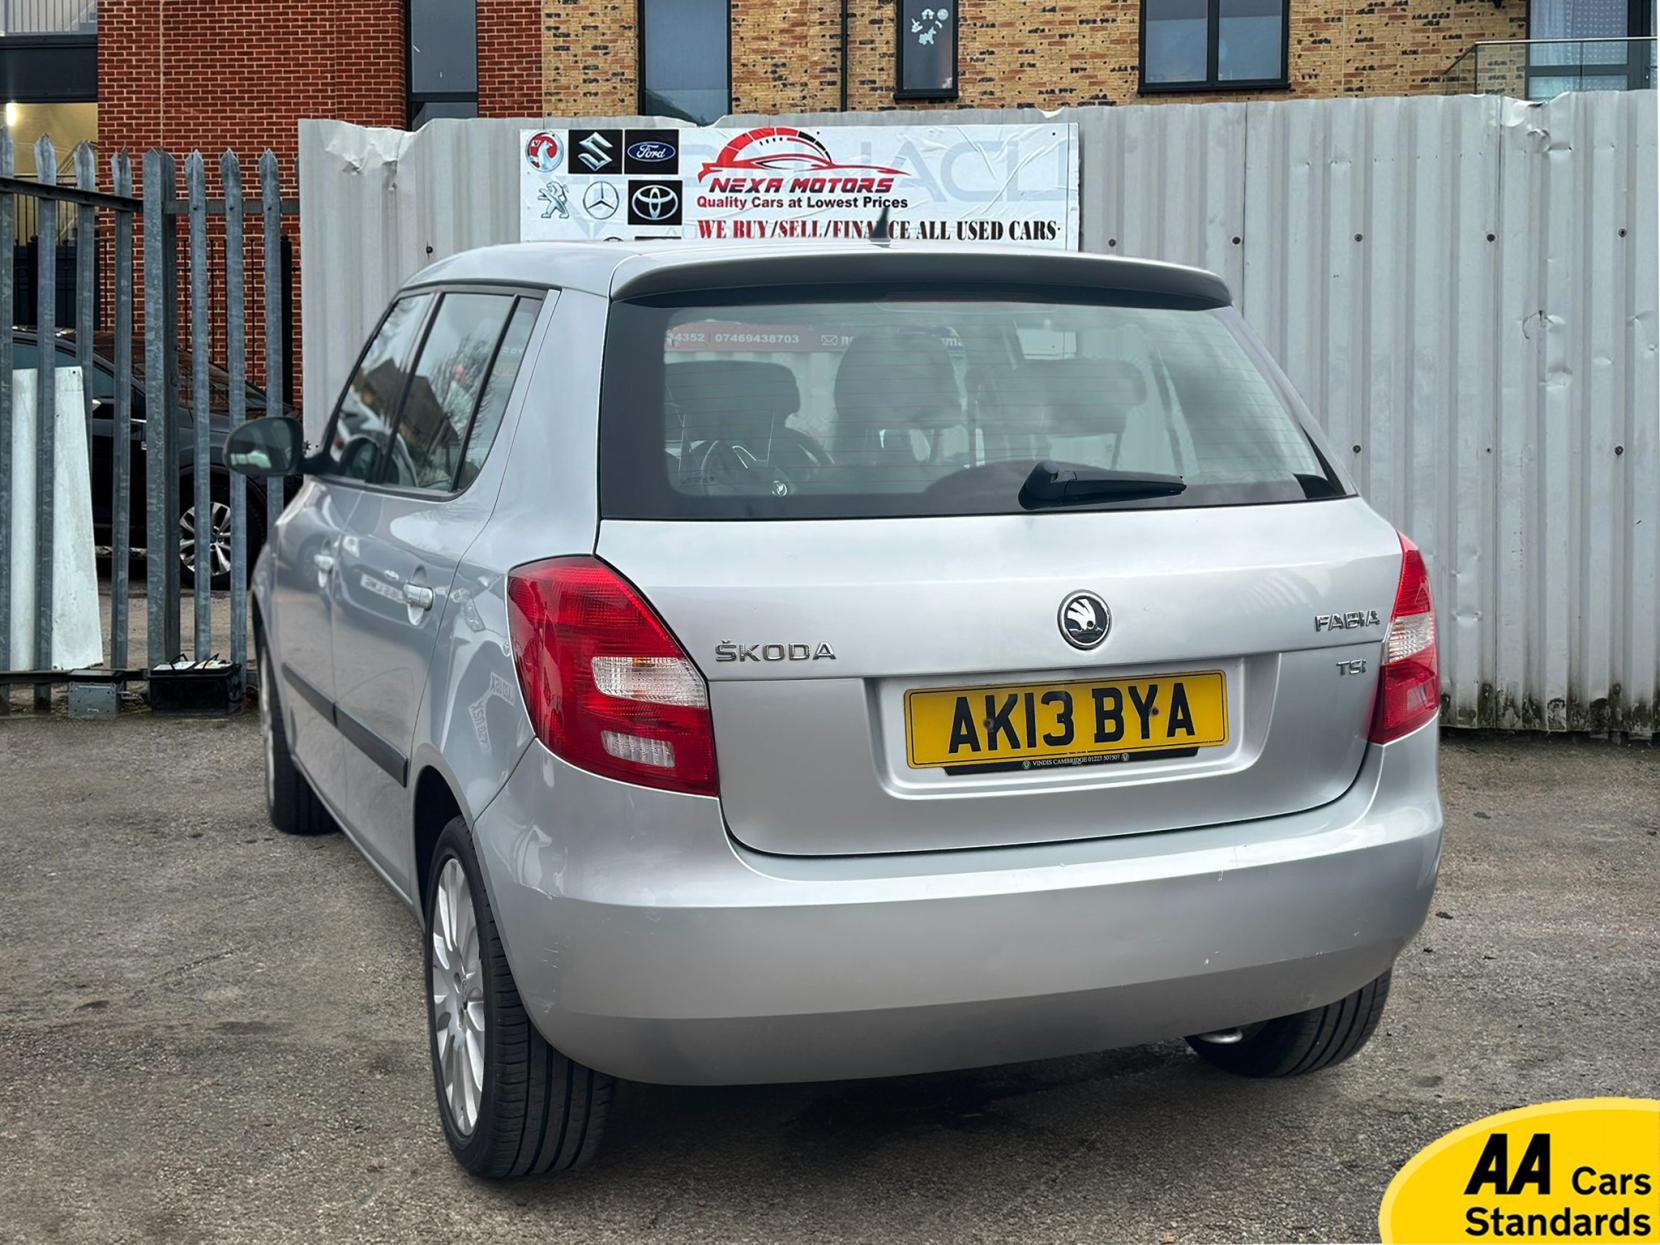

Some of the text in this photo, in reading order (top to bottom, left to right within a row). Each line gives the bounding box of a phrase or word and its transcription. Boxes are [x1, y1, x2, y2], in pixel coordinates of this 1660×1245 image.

[636, 144, 666, 158] Ford
[709, 177, 895, 193] NEXA MOTORS
[697, 196, 909, 211] Quality Cars at Lowest Prices
[697, 219, 1057, 240] WE BUY/SELL/FINACE ALL USED CARS
[1314, 609, 1381, 632] FABIA
[715, 640, 837, 662] ŠKODA
[948, 682, 1196, 754] AK13 BYA
